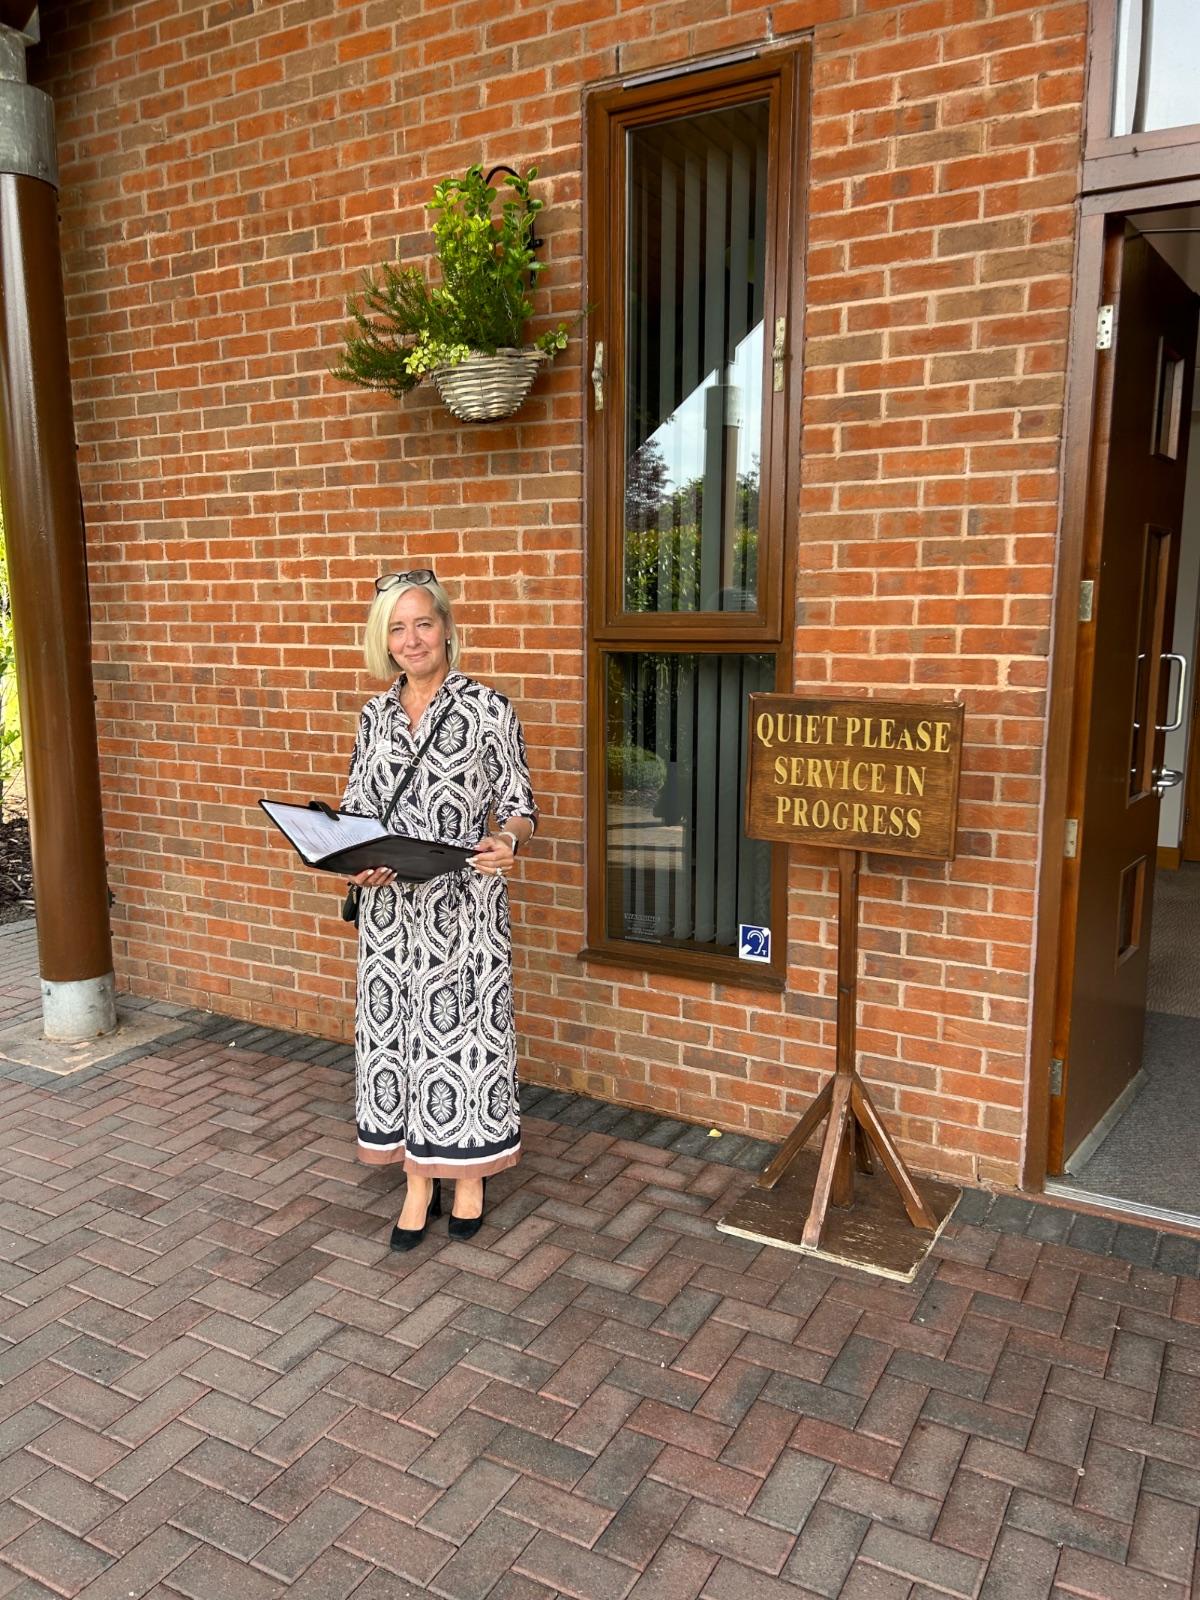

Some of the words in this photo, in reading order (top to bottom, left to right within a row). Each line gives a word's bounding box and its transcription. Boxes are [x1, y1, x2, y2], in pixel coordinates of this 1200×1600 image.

[757, 713, 838, 748] QUIET
[845, 717, 951, 753] PLEASE
[774, 756, 886, 793] SERVICE
[894, 765, 927, 797] IN
[776, 796, 922, 839] PROGRESS
